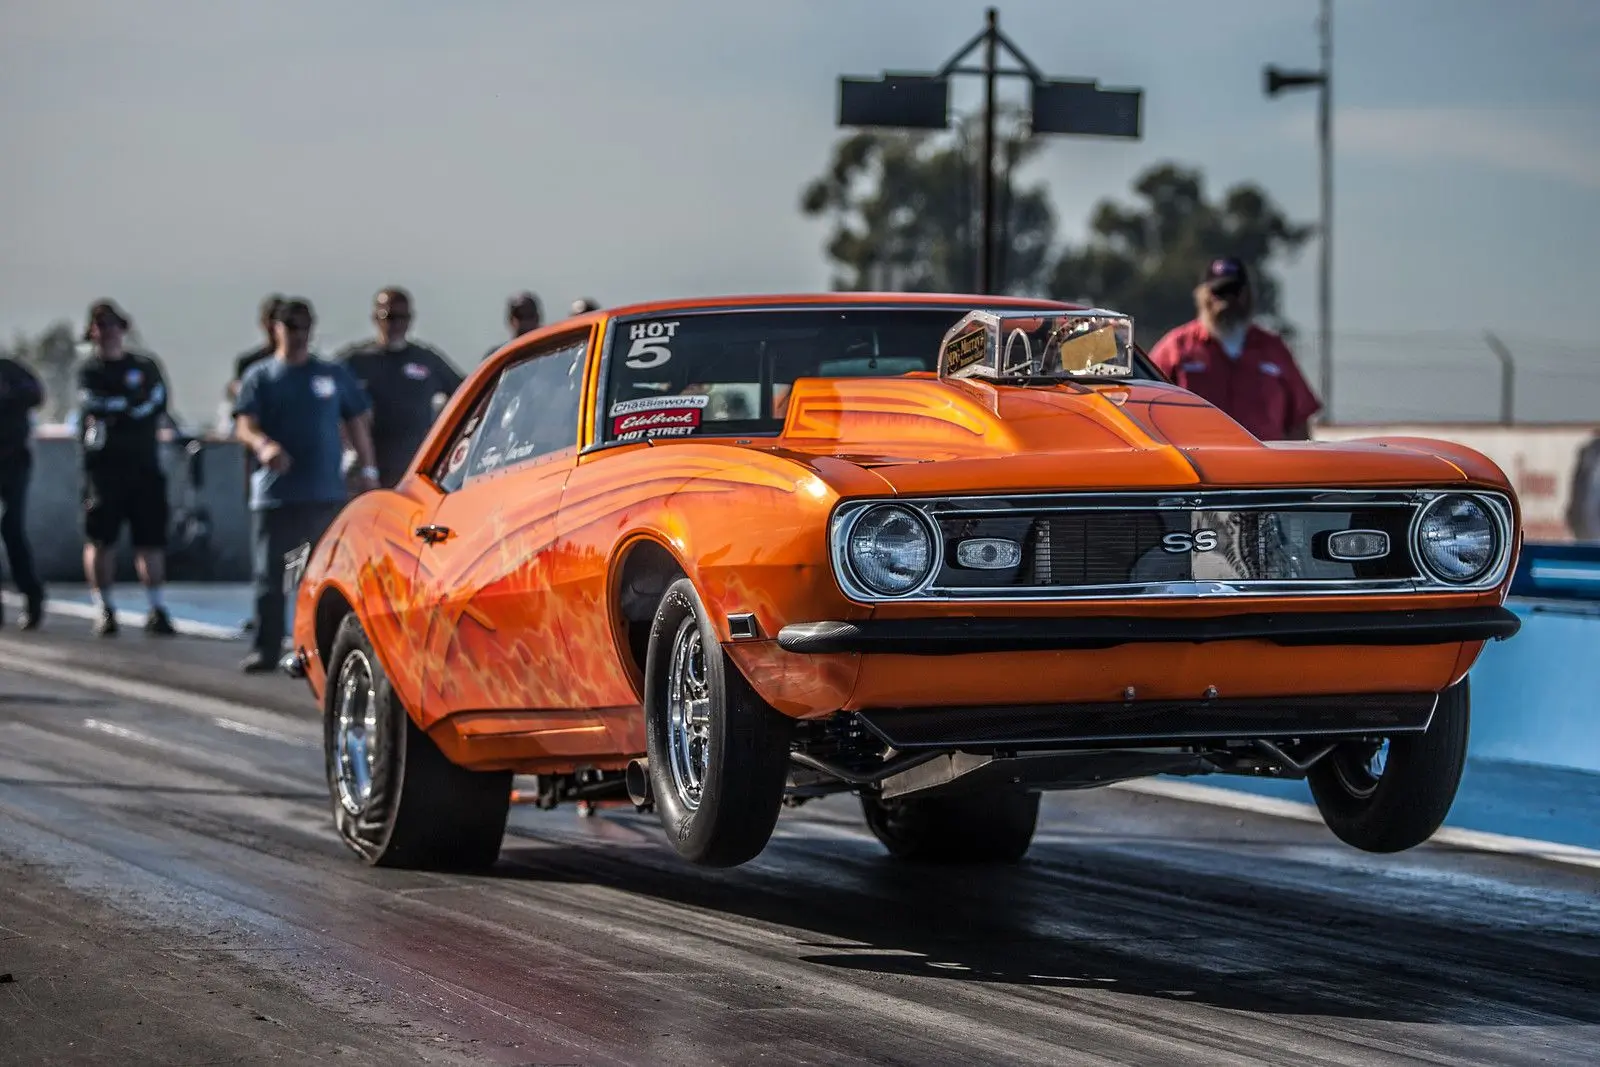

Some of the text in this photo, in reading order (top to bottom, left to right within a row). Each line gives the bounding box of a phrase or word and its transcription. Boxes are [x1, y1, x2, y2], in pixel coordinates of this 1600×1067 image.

[629, 322, 680, 340] HOT
[625, 336, 672, 369] 5
[620, 413, 693, 430] Edelbrock
[617, 426, 695, 441] HOT STREET
[1162, 530, 1218, 553] SS
